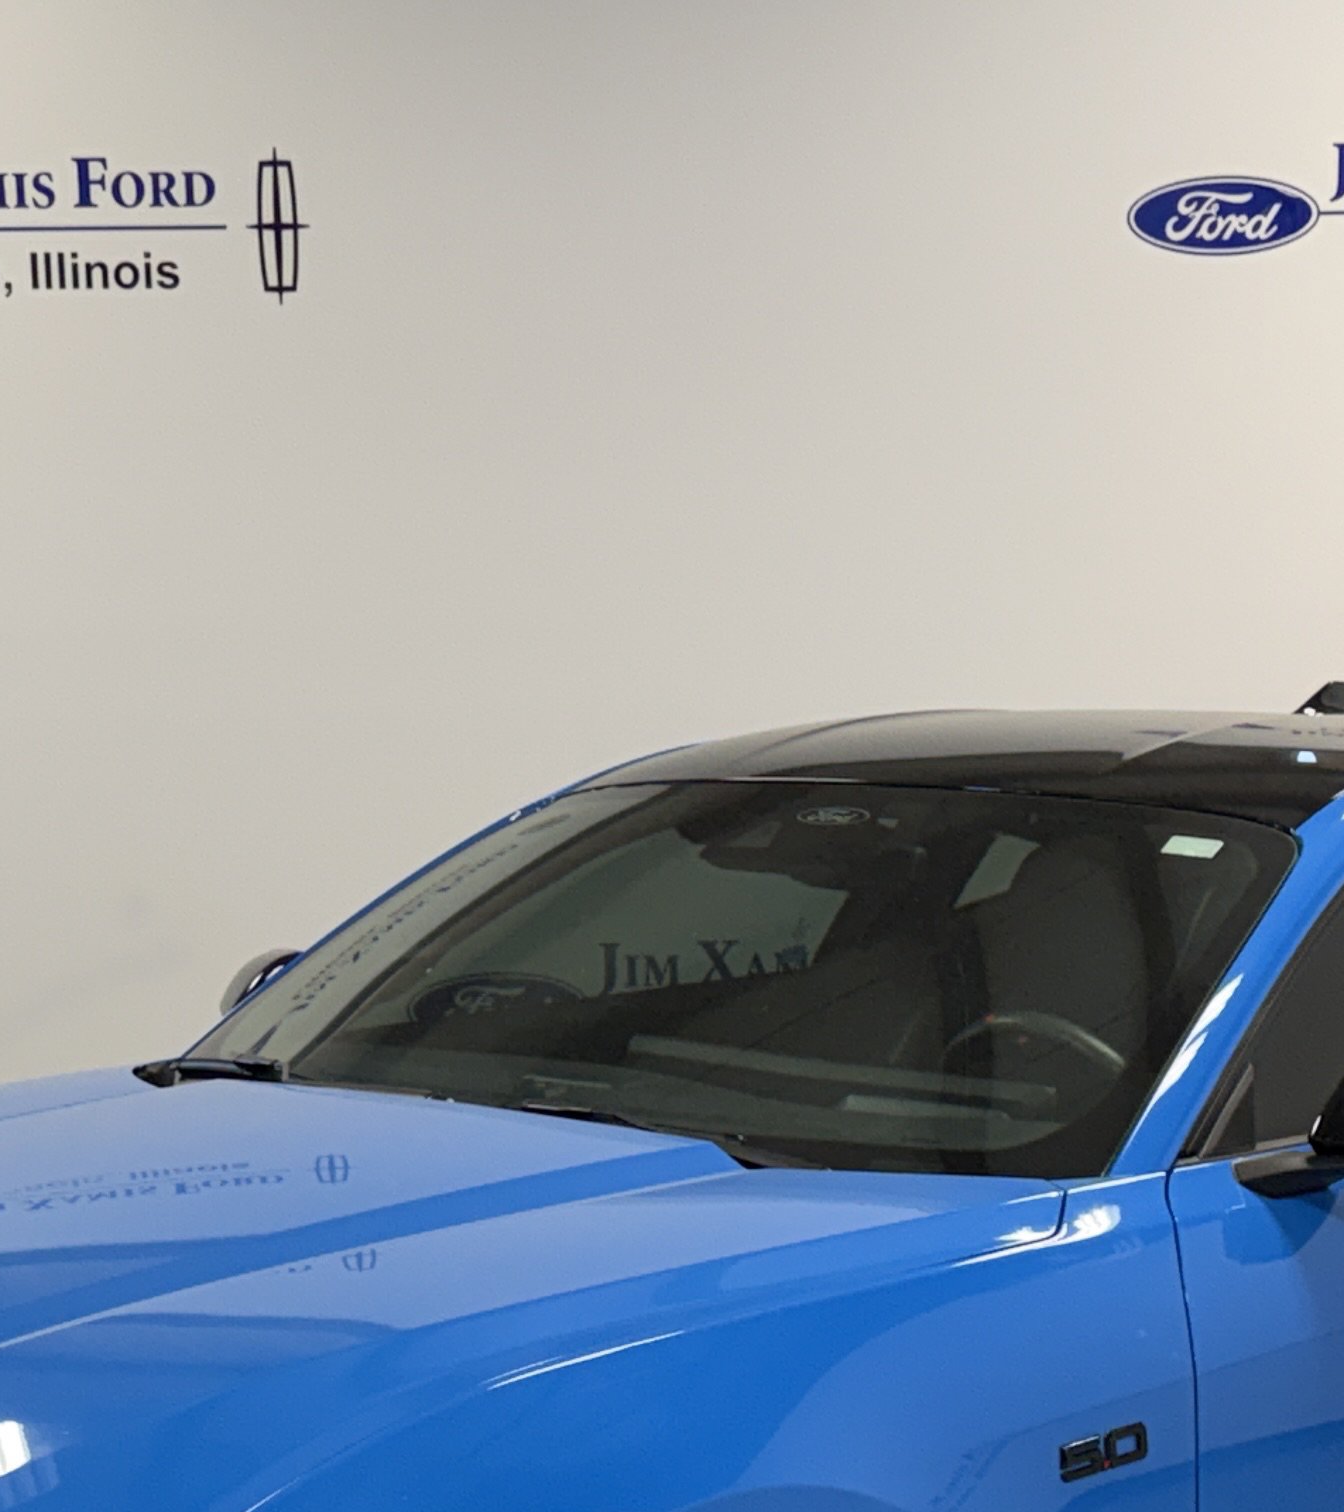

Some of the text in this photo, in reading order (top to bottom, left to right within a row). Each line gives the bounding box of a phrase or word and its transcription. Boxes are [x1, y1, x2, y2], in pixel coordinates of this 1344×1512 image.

[1164, 190, 1280, 242] Ford
[30, 252, 181, 290] Illinois
[1059, 1421, 1148, 1483] 5.0
